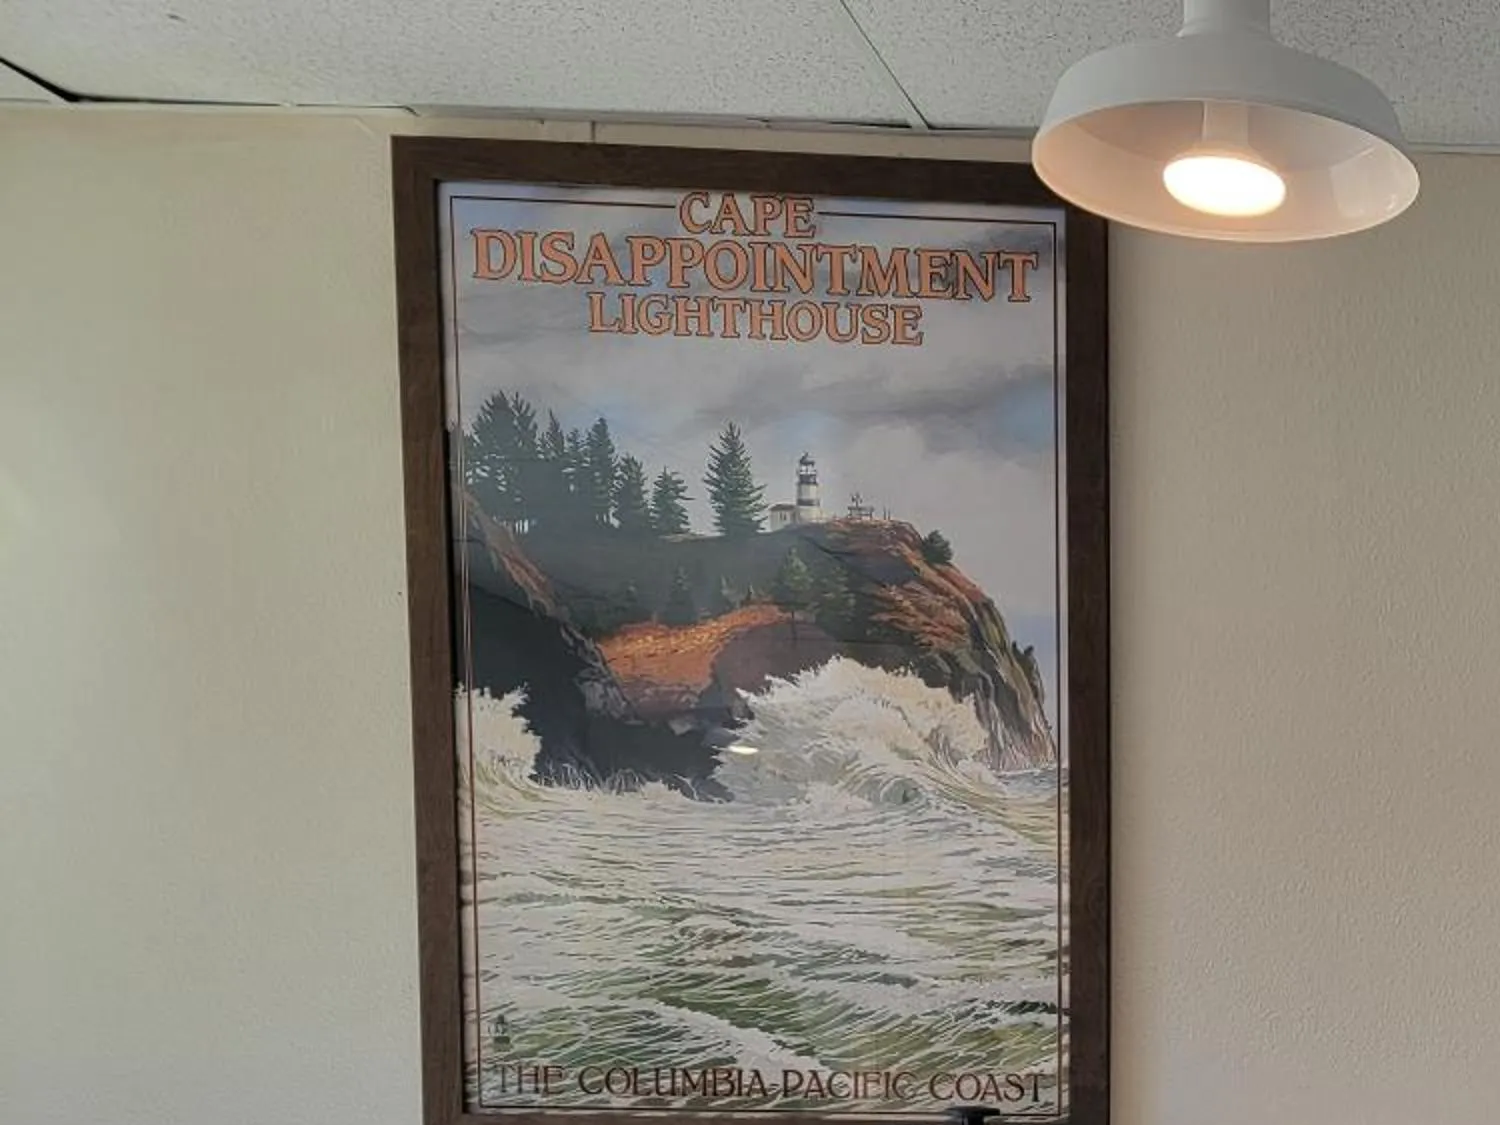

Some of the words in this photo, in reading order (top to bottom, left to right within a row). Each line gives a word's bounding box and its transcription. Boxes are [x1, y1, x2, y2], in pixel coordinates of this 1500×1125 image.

[679, 191, 817, 238] CAPE
[471, 227, 1039, 302] DISAPPOINTMENT
[587, 292, 924, 346] LIGHTHOUSE
[495, 1065, 565, 1095] THE
[929, 1072, 1047, 1102] COAST
